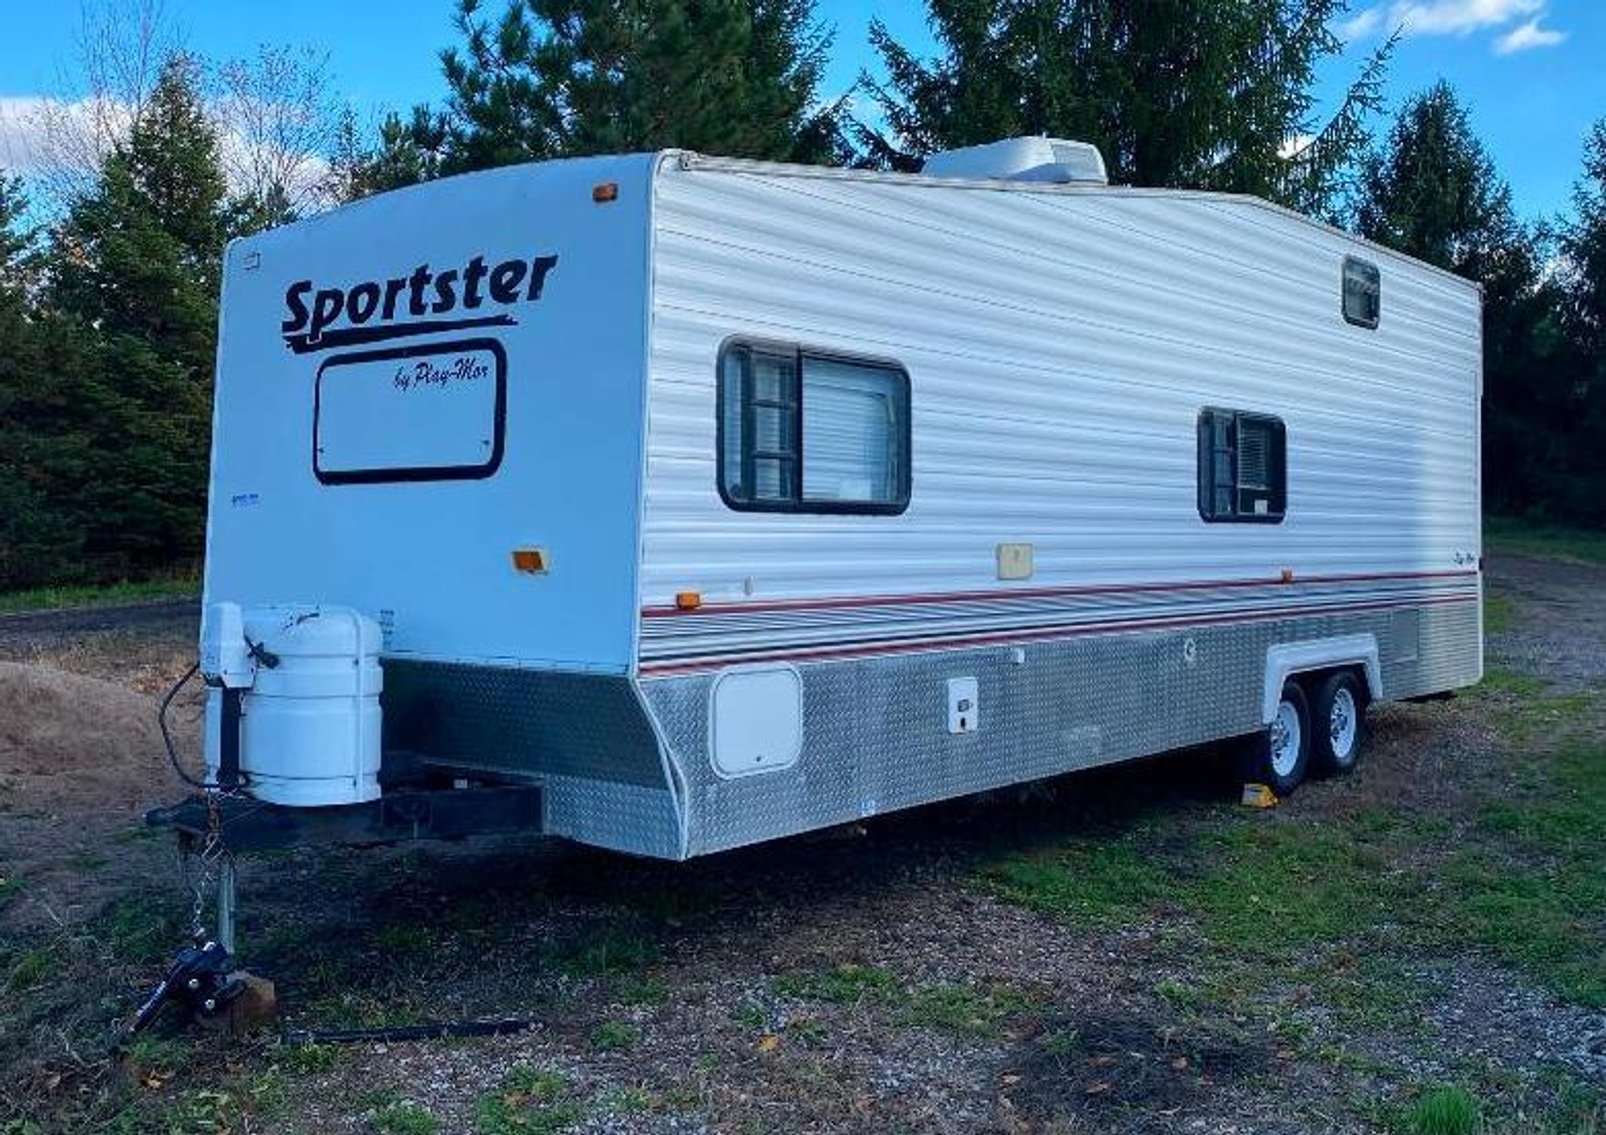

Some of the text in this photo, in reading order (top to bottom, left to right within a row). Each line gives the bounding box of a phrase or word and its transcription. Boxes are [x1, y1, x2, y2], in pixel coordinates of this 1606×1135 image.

[282, 255, 559, 343] Sportster
[394, 358, 489, 390] by Play-Mor
